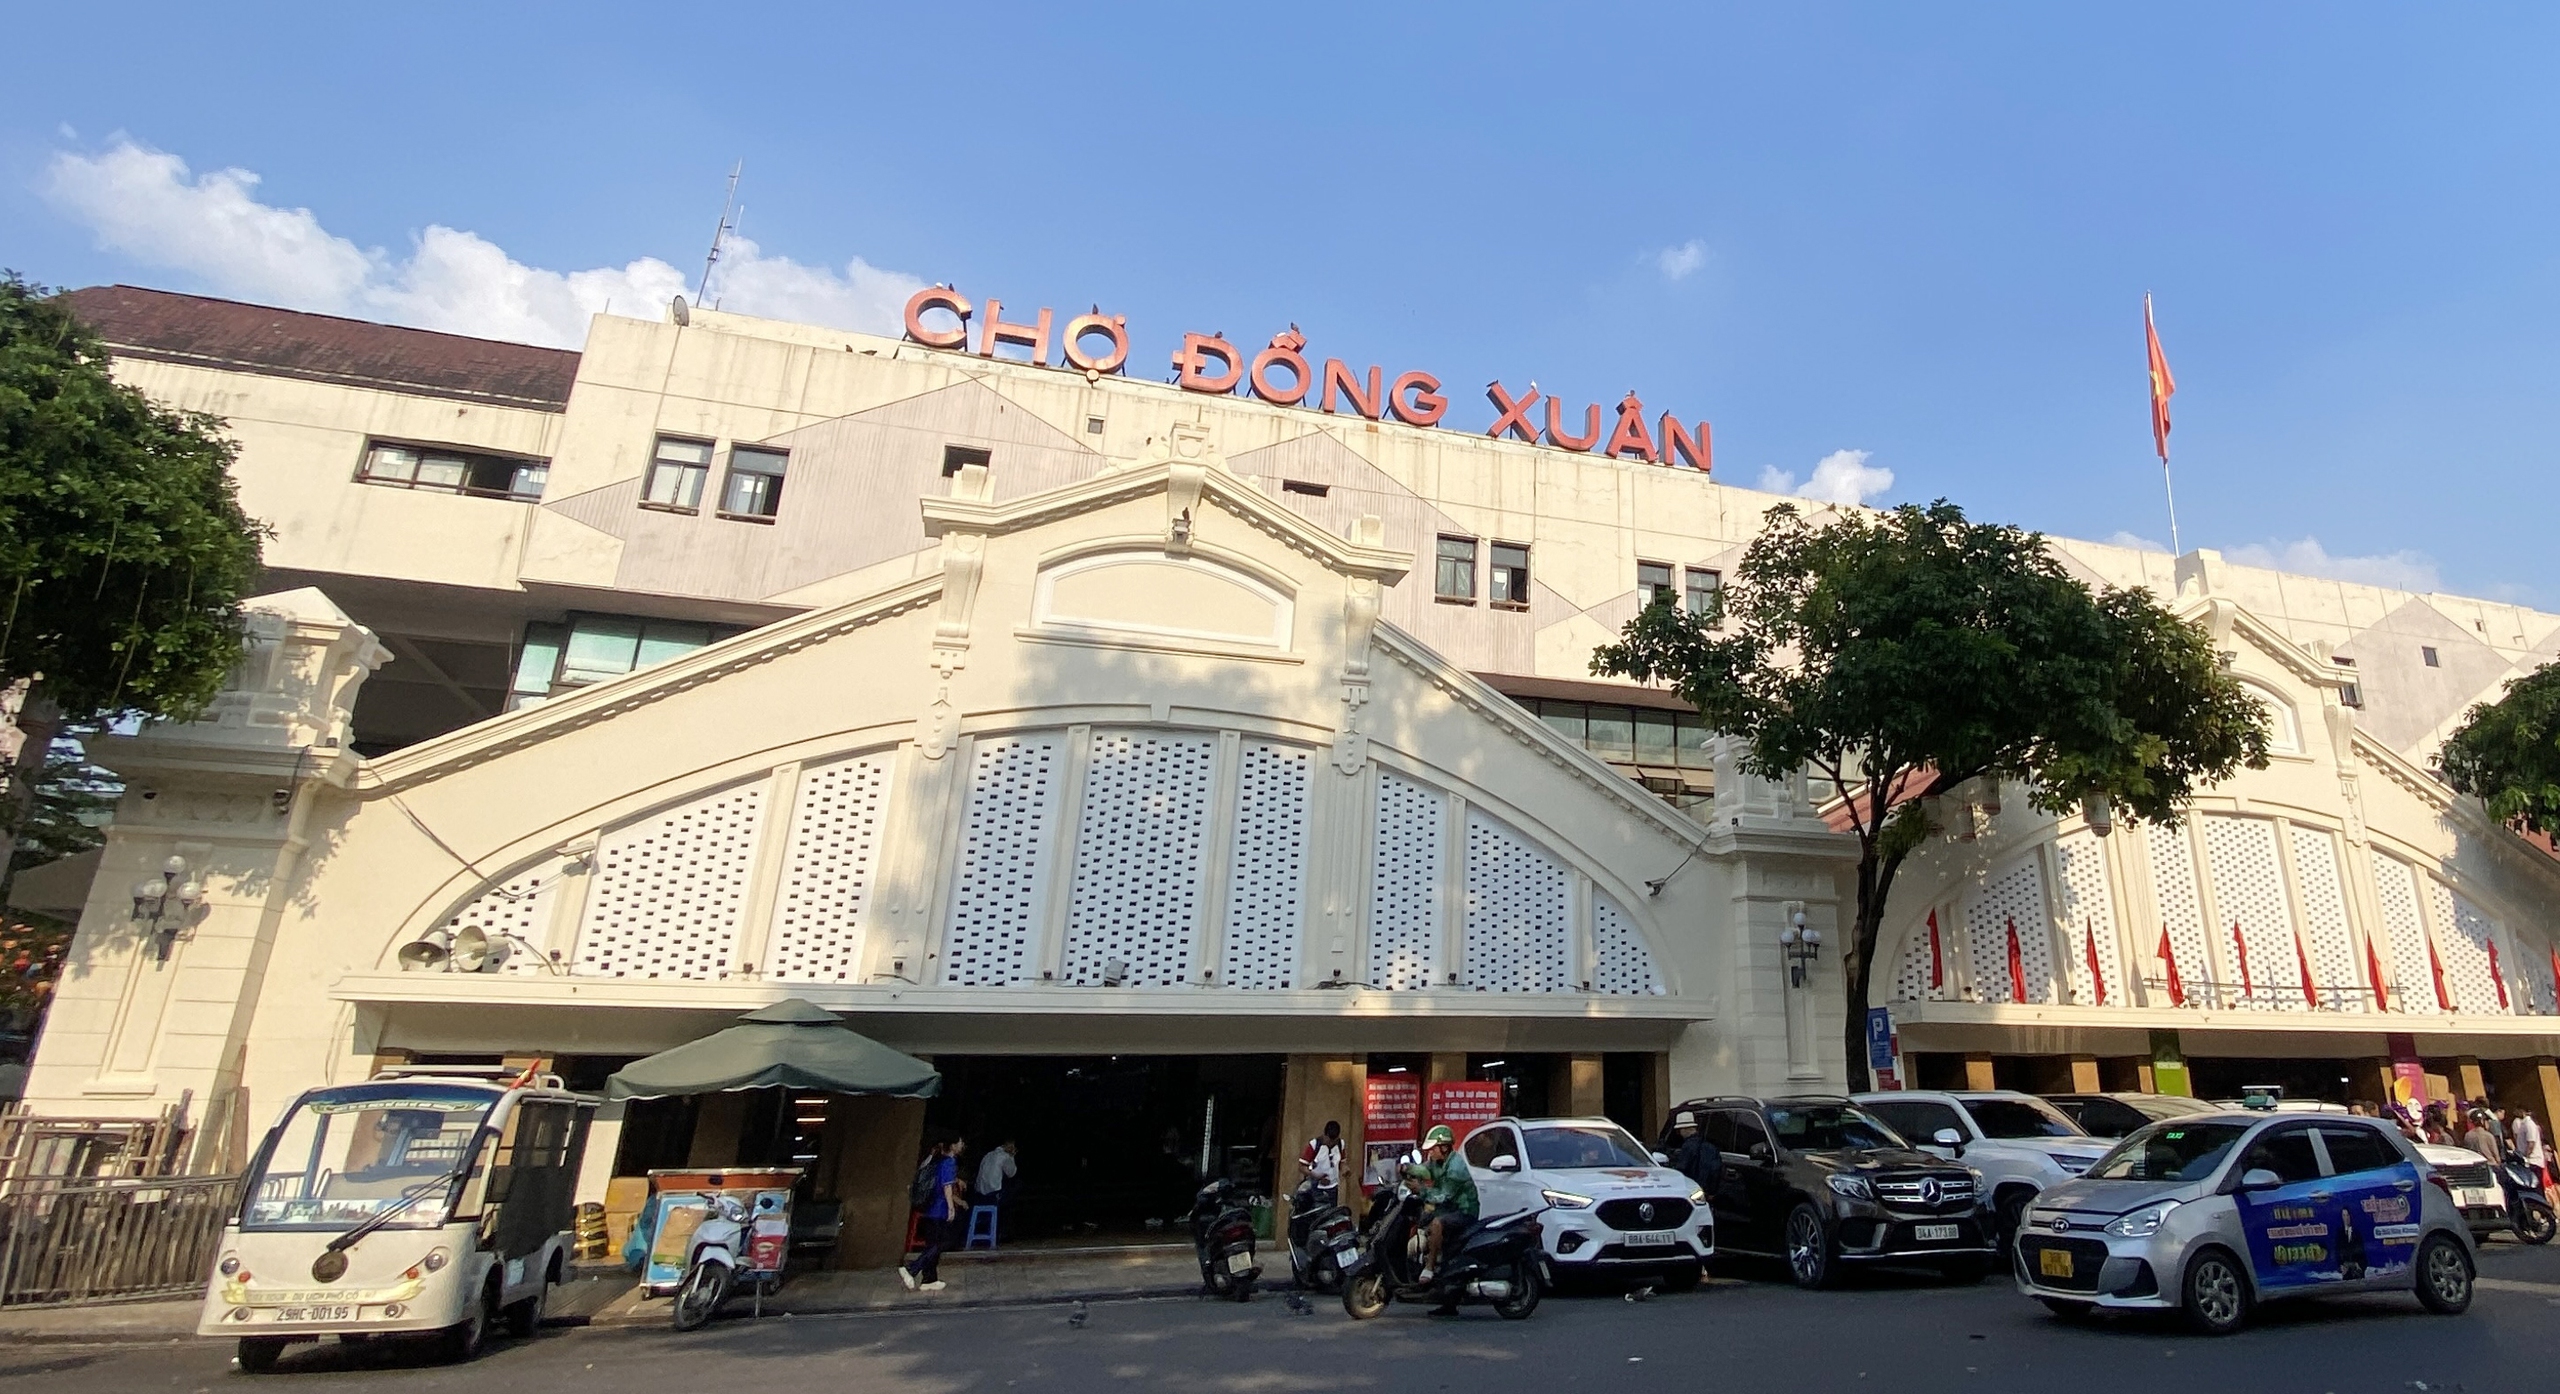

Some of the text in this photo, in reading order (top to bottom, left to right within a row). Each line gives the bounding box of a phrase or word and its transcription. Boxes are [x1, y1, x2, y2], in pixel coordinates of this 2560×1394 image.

[903, 287, 1713, 473] CHỢ ĐỒNG XUÂN
